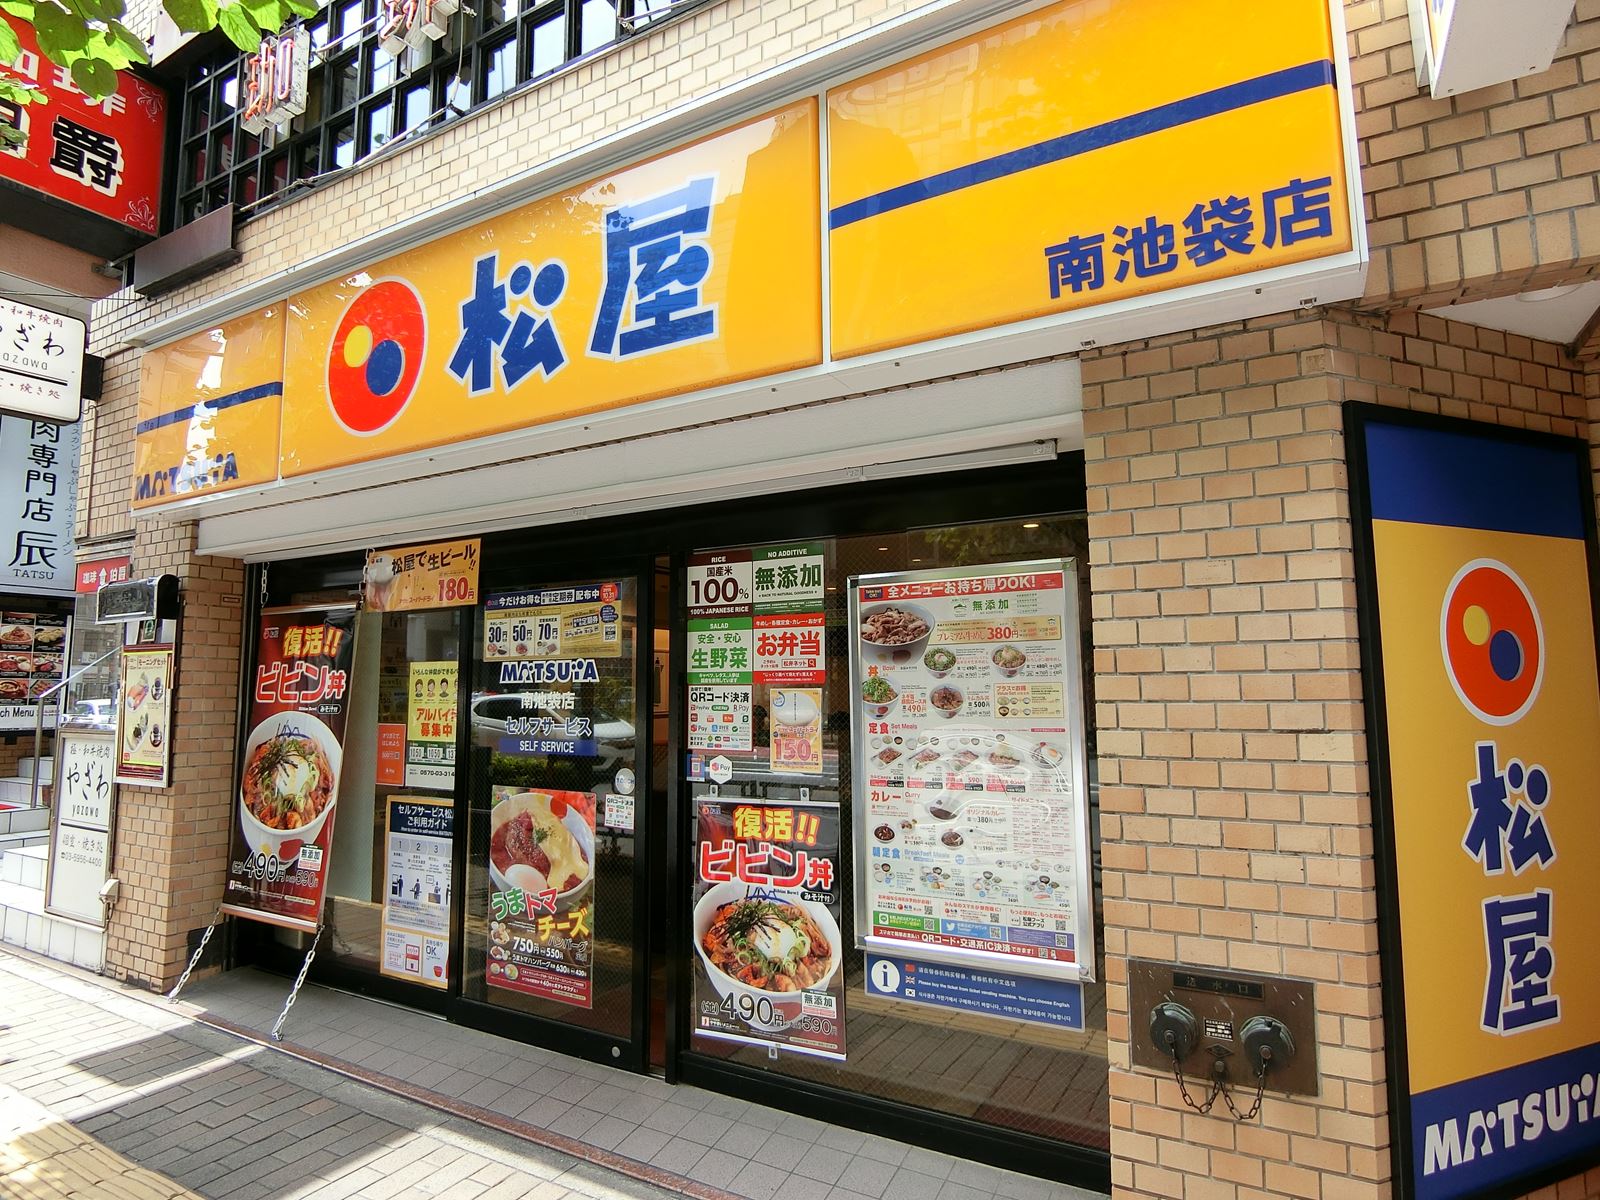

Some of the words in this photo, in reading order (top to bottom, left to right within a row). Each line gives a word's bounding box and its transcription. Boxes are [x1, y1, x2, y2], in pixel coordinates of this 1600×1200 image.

[1044, 176, 1333, 299] 南池袋店
[444, 170, 721, 398] 松屋
[0, 323, 65, 357] ざわ
[8, 530, 58, 569] 辰
[767, 551, 777, 559] NO
[777, 547, 809, 558] ADDITIVE
[711, 555, 728, 563] RICE
[13, 568, 55, 581] TATSU
[706, 565, 733, 577] 国産米
[755, 562, 822, 592] 無添加
[690, 576, 750, 605] 100%
[887, 575, 1036, 599] 全メニューお持ち帰りOK!
[690, 608, 705, 616] 100%
[705, 605, 735, 615] JAPANESE
[734, 604, 750, 613] RICE
[972, 598, 1010, 612] 無添加
[709, 622, 730, 630] SALAD
[986, 626, 1019, 640] 380円
[697, 632, 742, 645] 安全・安心
[756, 630, 821, 656] お弁当
[691, 646, 748, 669] 生野菜
[499, 658, 600, 684] MATSUYA
[256, 660, 347, 703] ビビン丼
[521, 691, 576, 710] 南池袋店
[690, 692, 750, 704] QRコード決済
[13, 706, 35, 718] Menu
[505, 716, 592, 737] セルフサービス
[868, 722, 889, 735] 定食
[891, 722, 901, 730] Set
[902, 722, 918, 730] Meals
[519, 740, 538, 752] SELF
[541, 741, 575, 754] SERVICE
[773, 738, 819, 762] 150円
[66, 761, 109, 800] やざわ
[871, 790, 901, 803] カレー
[904, 791, 921, 800] Curry
[398, 804, 454, 819] セルフサービス松
[407, 816, 448, 829] ご利用ガイド
[416, 842, 421, 852] 2
[433, 844, 438, 854] 3
[700, 839, 834, 890] ビビン丼
[1461, 738, 1562, 1036] 松屋
[491, 886, 558, 921] うまトマ
[537, 906, 591, 942] チーズ
[425, 945, 436, 956] OK
[803, 993, 834, 1008] 無添加
[1423, 1072, 1600, 1177] MATSUY
